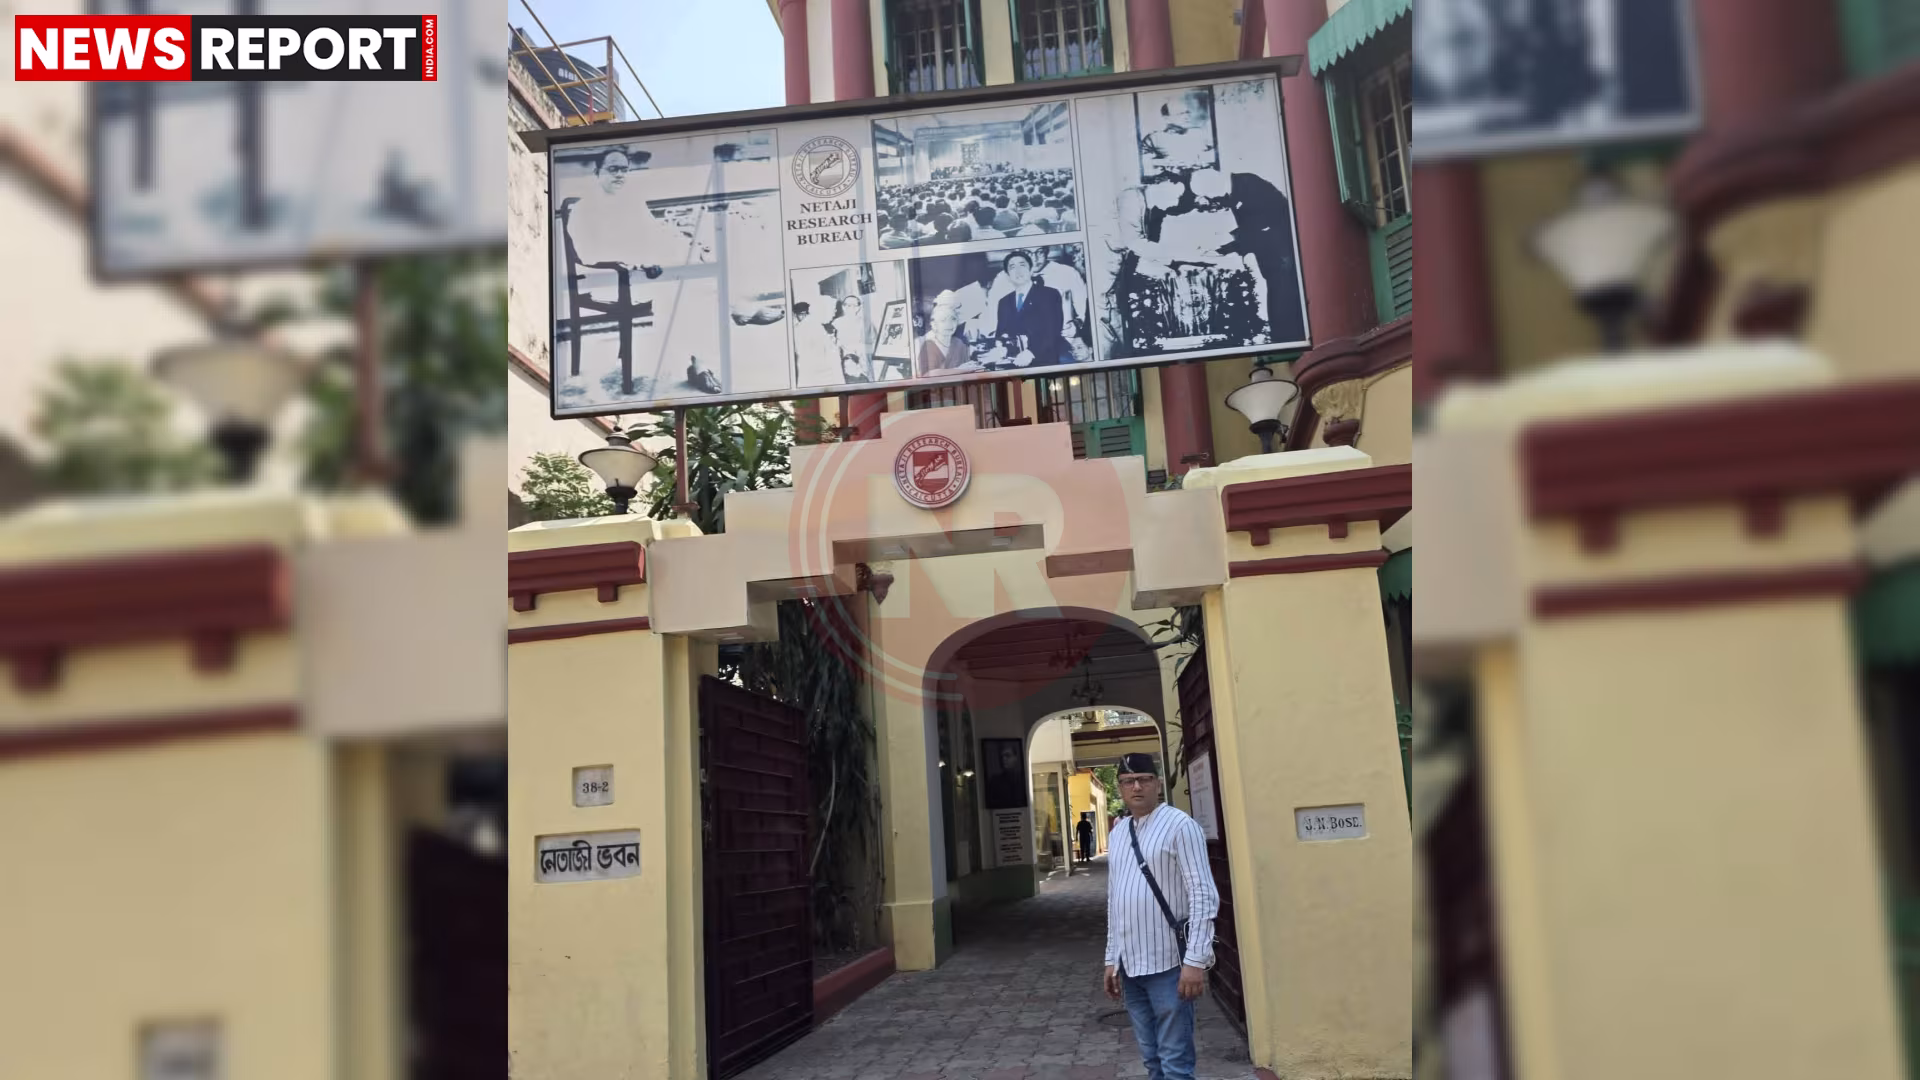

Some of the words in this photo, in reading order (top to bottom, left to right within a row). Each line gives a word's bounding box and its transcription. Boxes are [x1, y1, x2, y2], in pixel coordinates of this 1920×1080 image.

[804, 139, 844, 152] RESEARCH
[847, 148, 857, 179] BUREAU
[805, 183, 848, 195] CALCUTTA
[800, 199, 857, 213] NETAJI
[786, 213, 872, 230] RESEARCH
[797, 230, 864, 245] BUREAU
[907, 438, 950, 454] RESEARCH
[952, 449, 963, 483] BUREAU
[908, 488, 954, 501] CALCUTTA
[582, 781, 609, 793] 38-2
[540, 840, 592, 874] নেতাজী
[597, 842, 640, 869] ভবন
